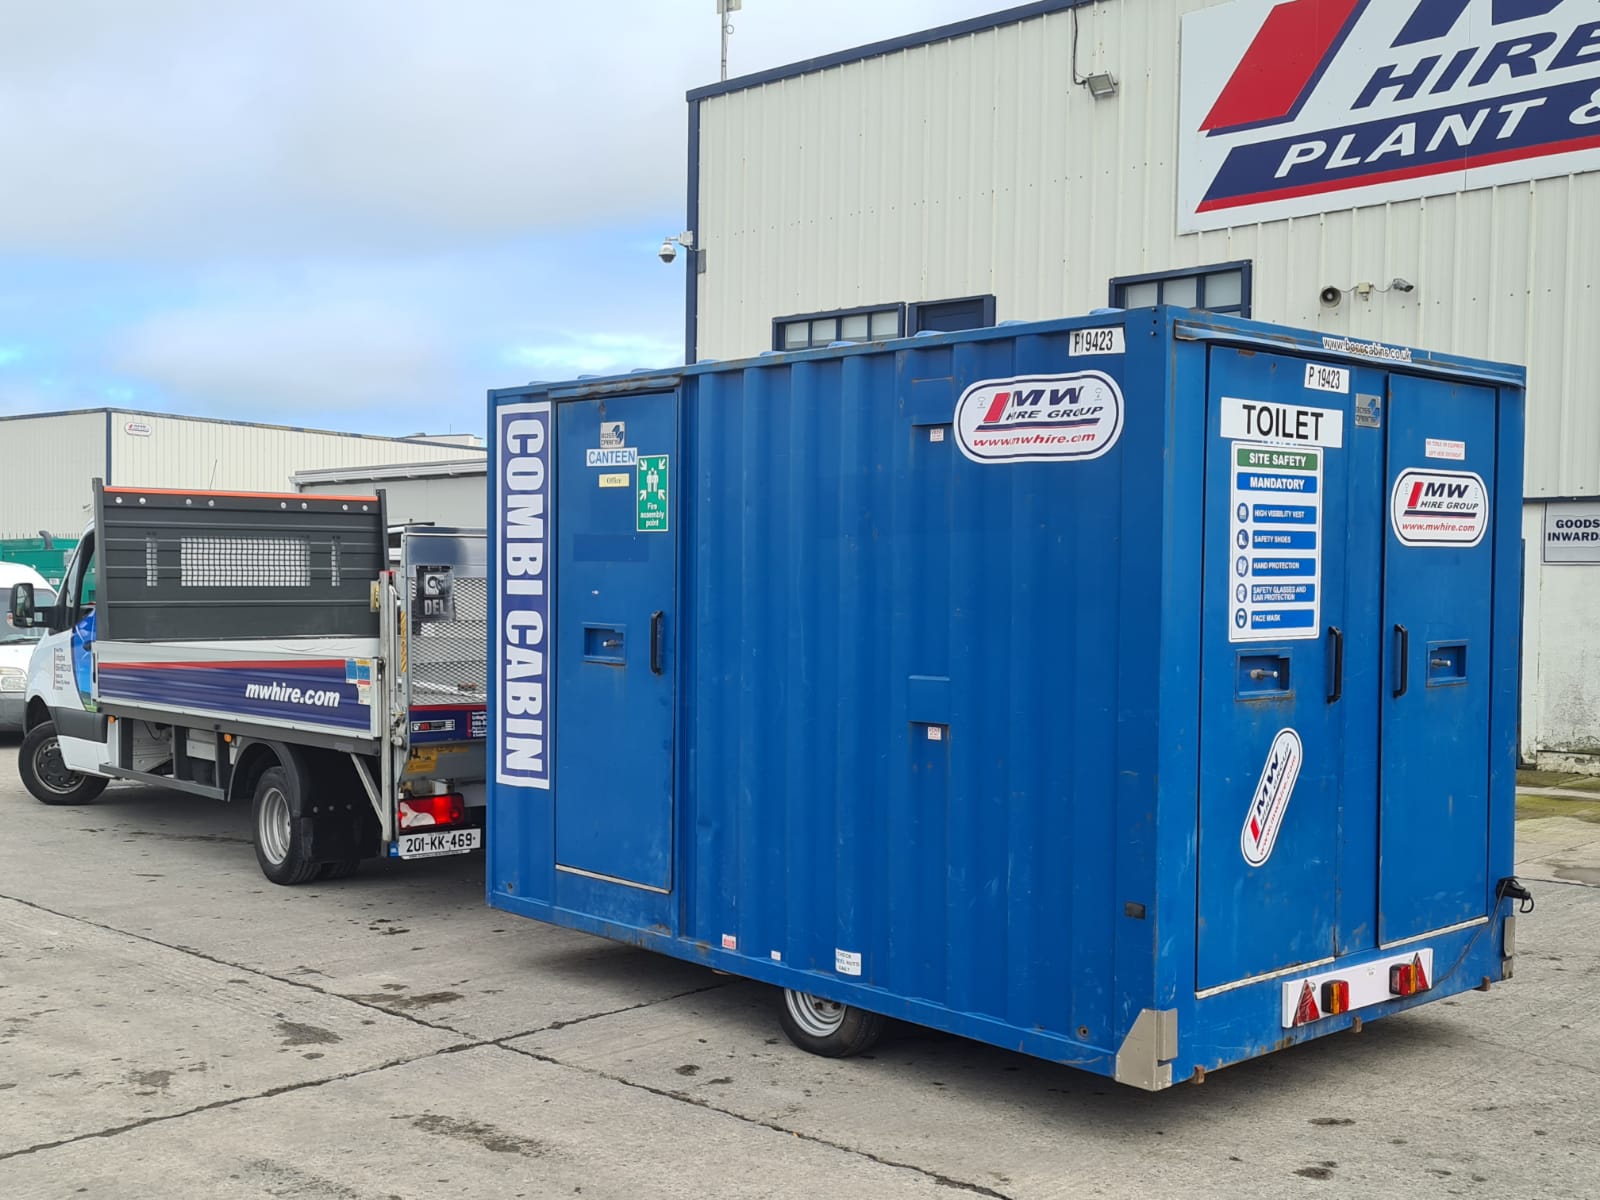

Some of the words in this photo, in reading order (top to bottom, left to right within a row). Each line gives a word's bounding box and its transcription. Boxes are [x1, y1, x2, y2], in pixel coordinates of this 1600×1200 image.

[1350, 21, 1600, 110] HIRE
[1274, 97, 1547, 179] PLANT
[1308, 366, 1314, 385] P
[1317, 369, 1341, 389] 19423
[1011, 386, 1084, 407] MW
[1242, 404, 1324, 441] TOILET
[589, 450, 635, 464] CANTEEN
[1249, 453, 1270, 465] SITE
[1272, 454, 1306, 467] SAFETY
[1250, 477, 1305, 490] MANDATORY
[1424, 482, 1469, 498] MW
[506, 419, 545, 595] COMBI
[1420, 501, 1444, 509] HIRE
[1446, 502, 1479, 510] GROUP
[640, 511, 664, 519] assembly
[1556, 519, 1600, 528] GOODS
[1402, 522, 1475, 532] www.mwhire.com
[1548, 532, 1600, 541] INWARD
[424, 600, 447, 615] DEL
[245, 681, 340, 707] mwhire.com
[505, 610, 544, 772] CABIN
[1257, 750, 1279, 816] MW
[406, 833, 473, 853] 201-KK-469
